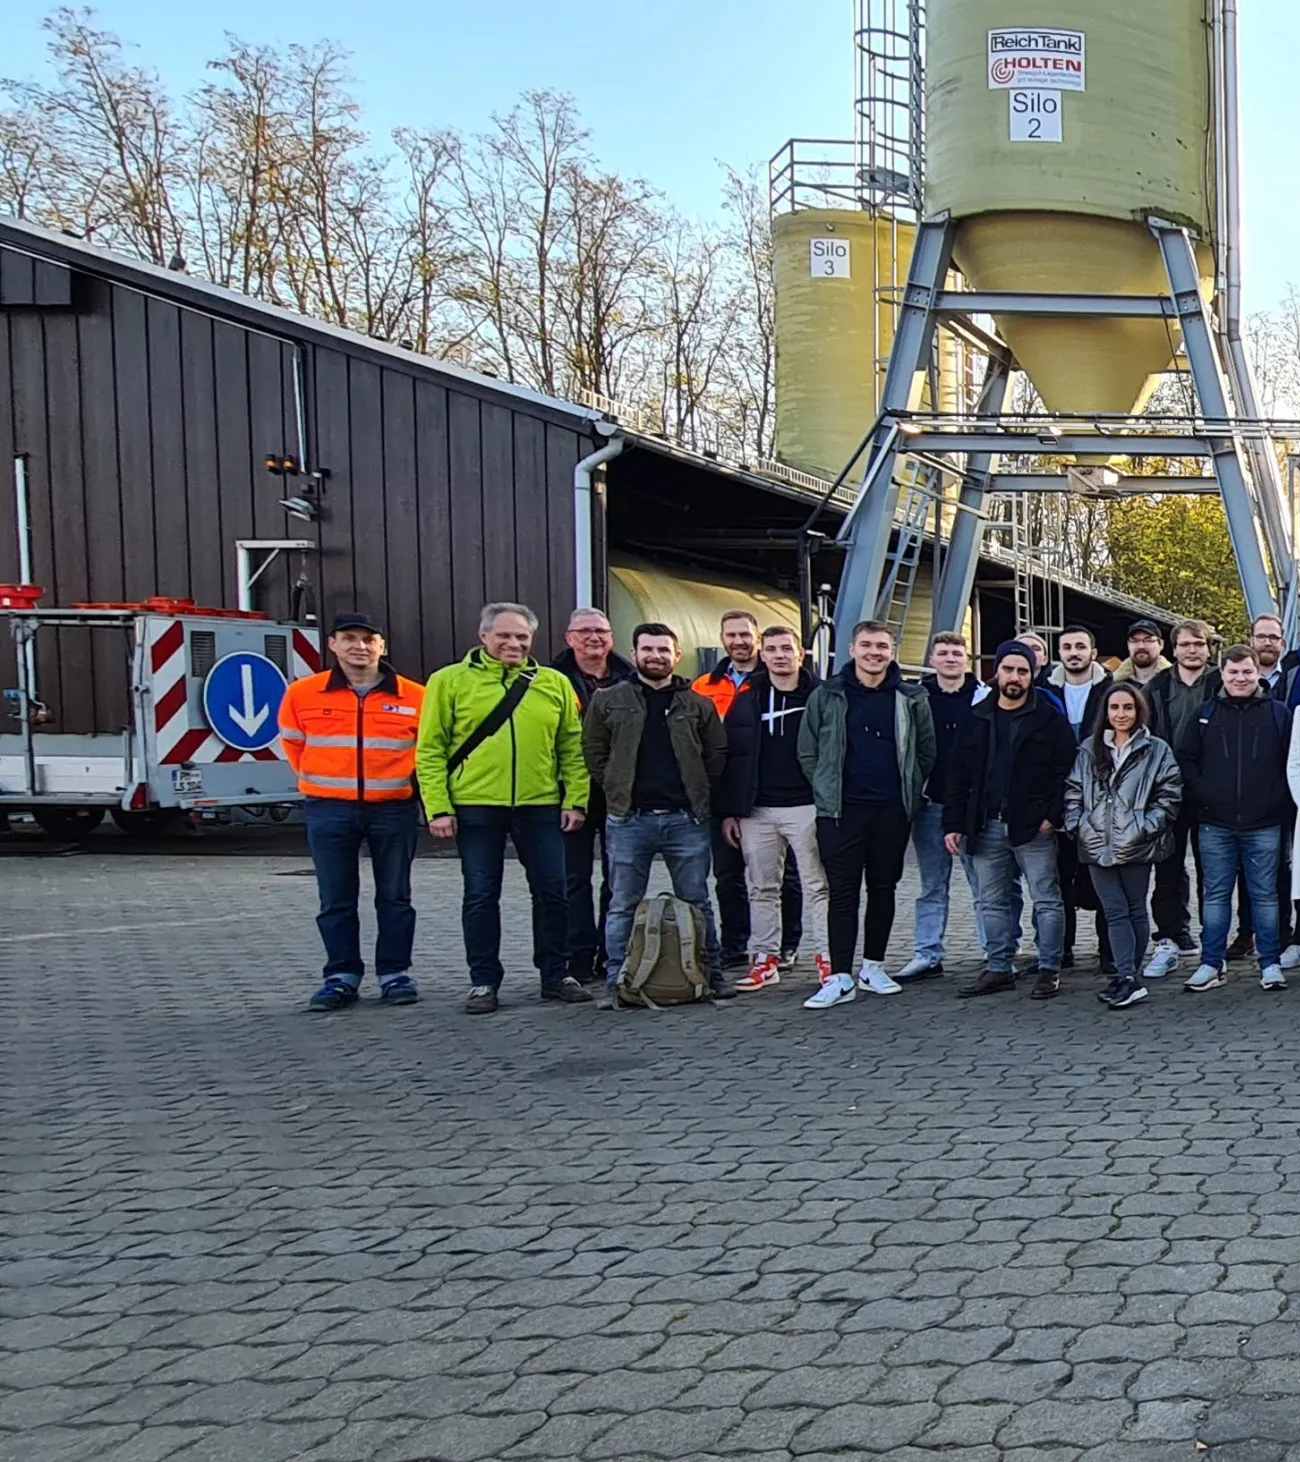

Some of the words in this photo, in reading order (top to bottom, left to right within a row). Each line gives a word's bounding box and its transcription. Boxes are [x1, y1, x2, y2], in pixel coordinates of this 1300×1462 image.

[1004, 57, 1082, 72] HOLTEN
[1013, 92, 1057, 113] Silo
[1028, 118, 1041, 138] 2
[813, 240, 846, 257] Silo
[824, 260, 835, 275] 3
